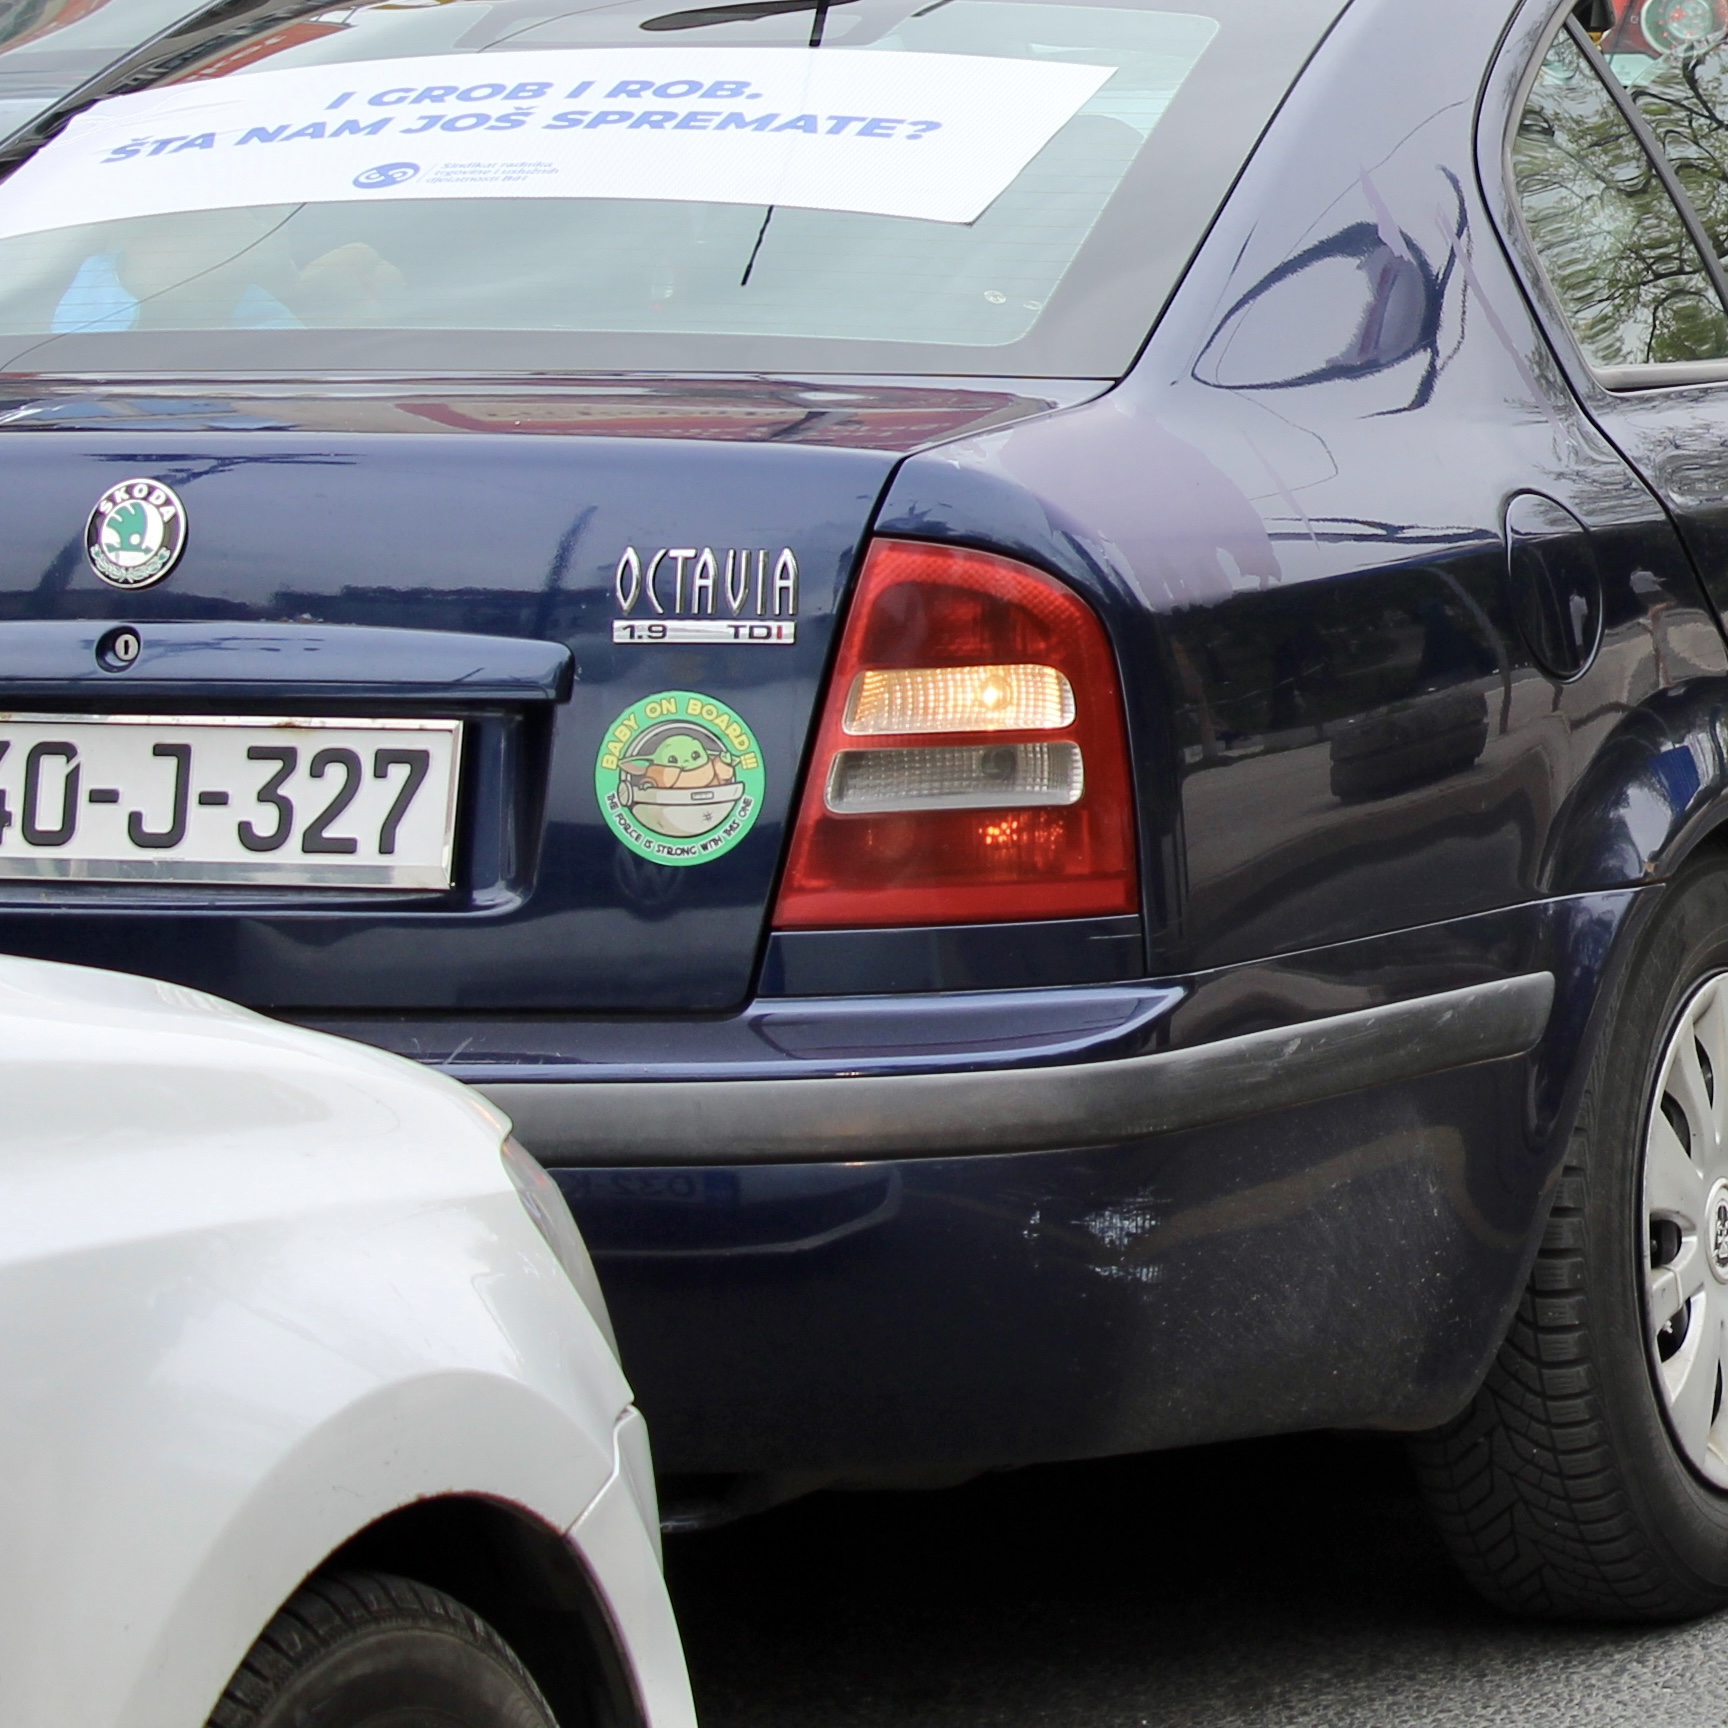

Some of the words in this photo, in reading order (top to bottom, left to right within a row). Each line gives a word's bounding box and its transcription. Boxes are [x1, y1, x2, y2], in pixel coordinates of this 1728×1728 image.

[325, 90, 356, 111] I
[366, 80, 555, 108] GROB
[565, 80, 598, 100] I
[602, 79, 764, 101] ROB.
[99, 131, 217, 164] ŠTA
[233, 115, 397, 148] NAM
[399, 105, 539, 135] JOŠ
[541, 109, 944, 142] SPREMATE?
[615, 545, 798, 616] OCTAVIA
[621, 624, 667, 640] 1.9
[727, 624, 783, 640] TDI
[601, 712, 640, 771] BABY
[644, 696, 678, 719] ON
[686, 697, 751, 753] BOARD
[606, 792, 619, 811] THE
[614, 812, 642, 843] FORCE
[643, 838, 654, 850] IS
[655, 843, 698, 857] STRONG
[700, 835, 724, 853] WITH
[722, 820, 741, 838] THIS
[737, 797, 754, 819] ONE
